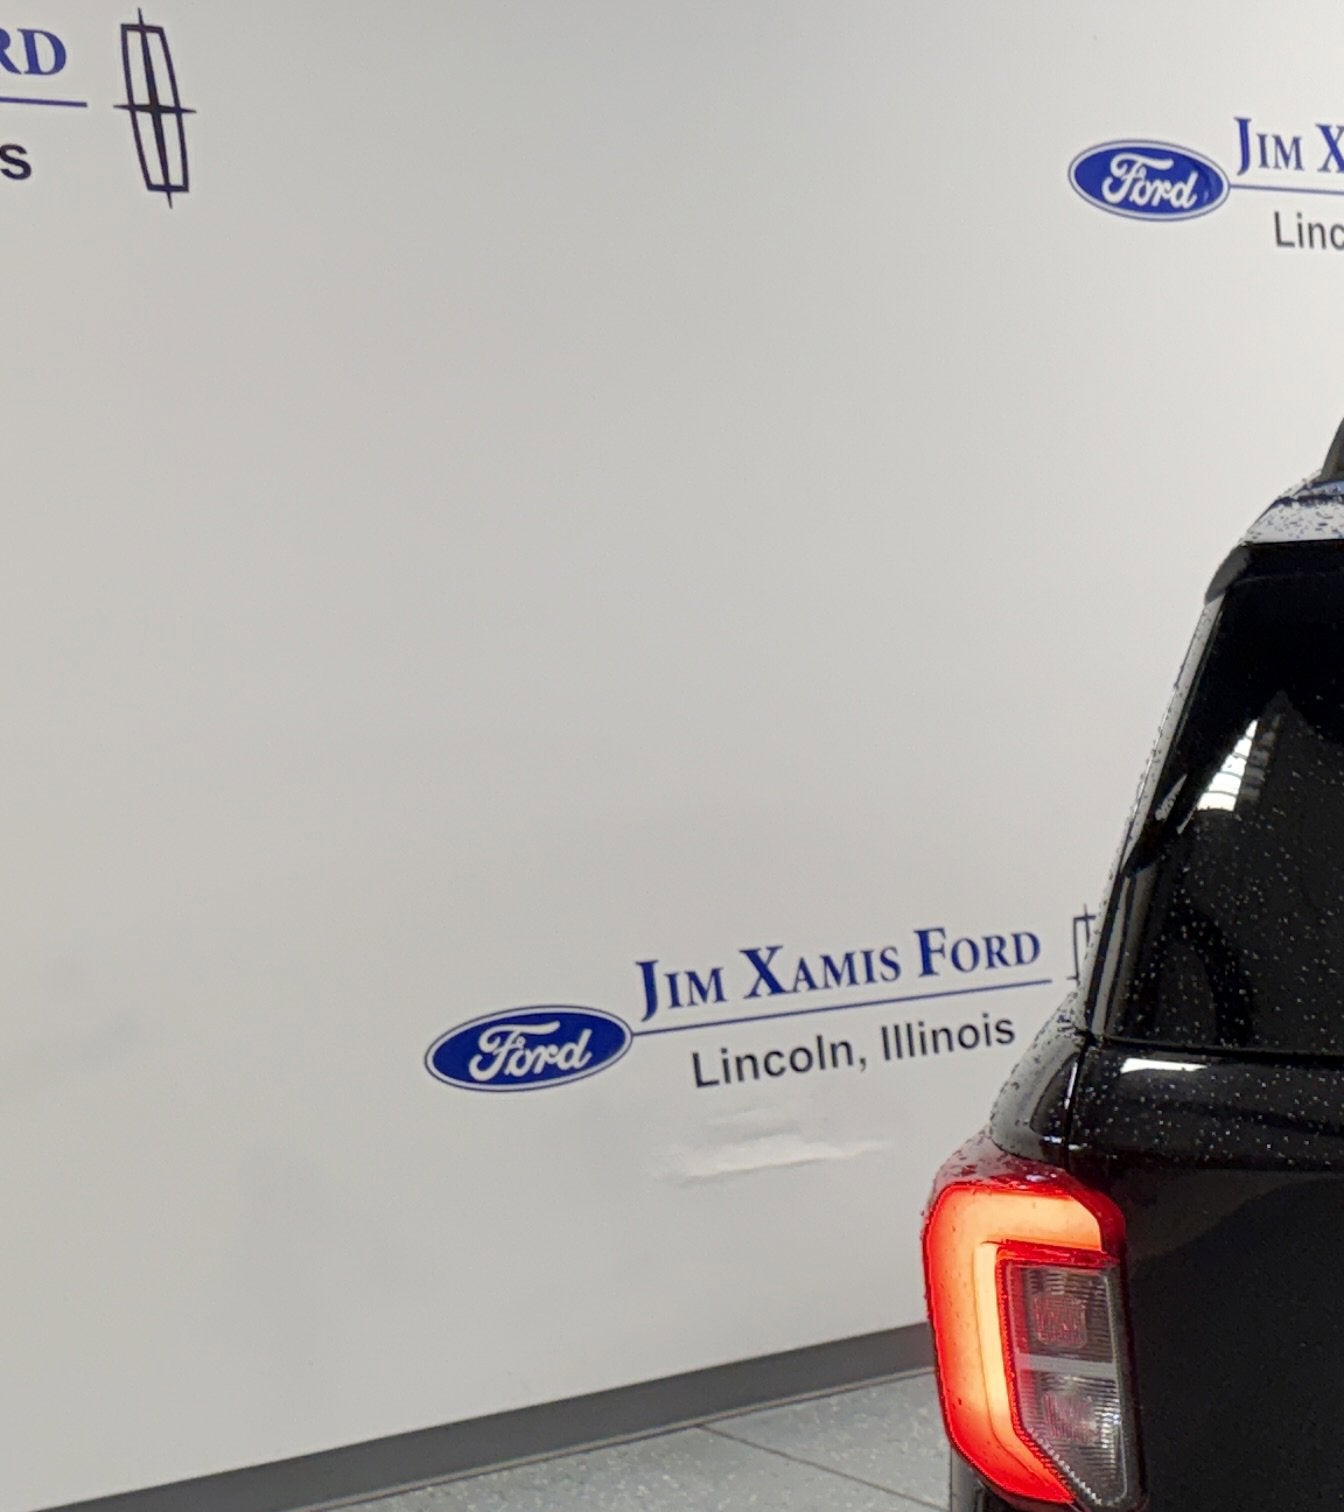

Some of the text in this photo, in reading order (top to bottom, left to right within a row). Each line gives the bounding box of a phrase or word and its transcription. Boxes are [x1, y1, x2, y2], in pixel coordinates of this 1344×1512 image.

[1233, 117, 1303, 176] JIM
[1101, 153, 1199, 210] Ford
[635, 927, 1041, 1022] JIM XAMIS FORD
[468, 1021, 593, 1081] Ford
[691, 1013, 1016, 1088] Lincoln, Illinois
